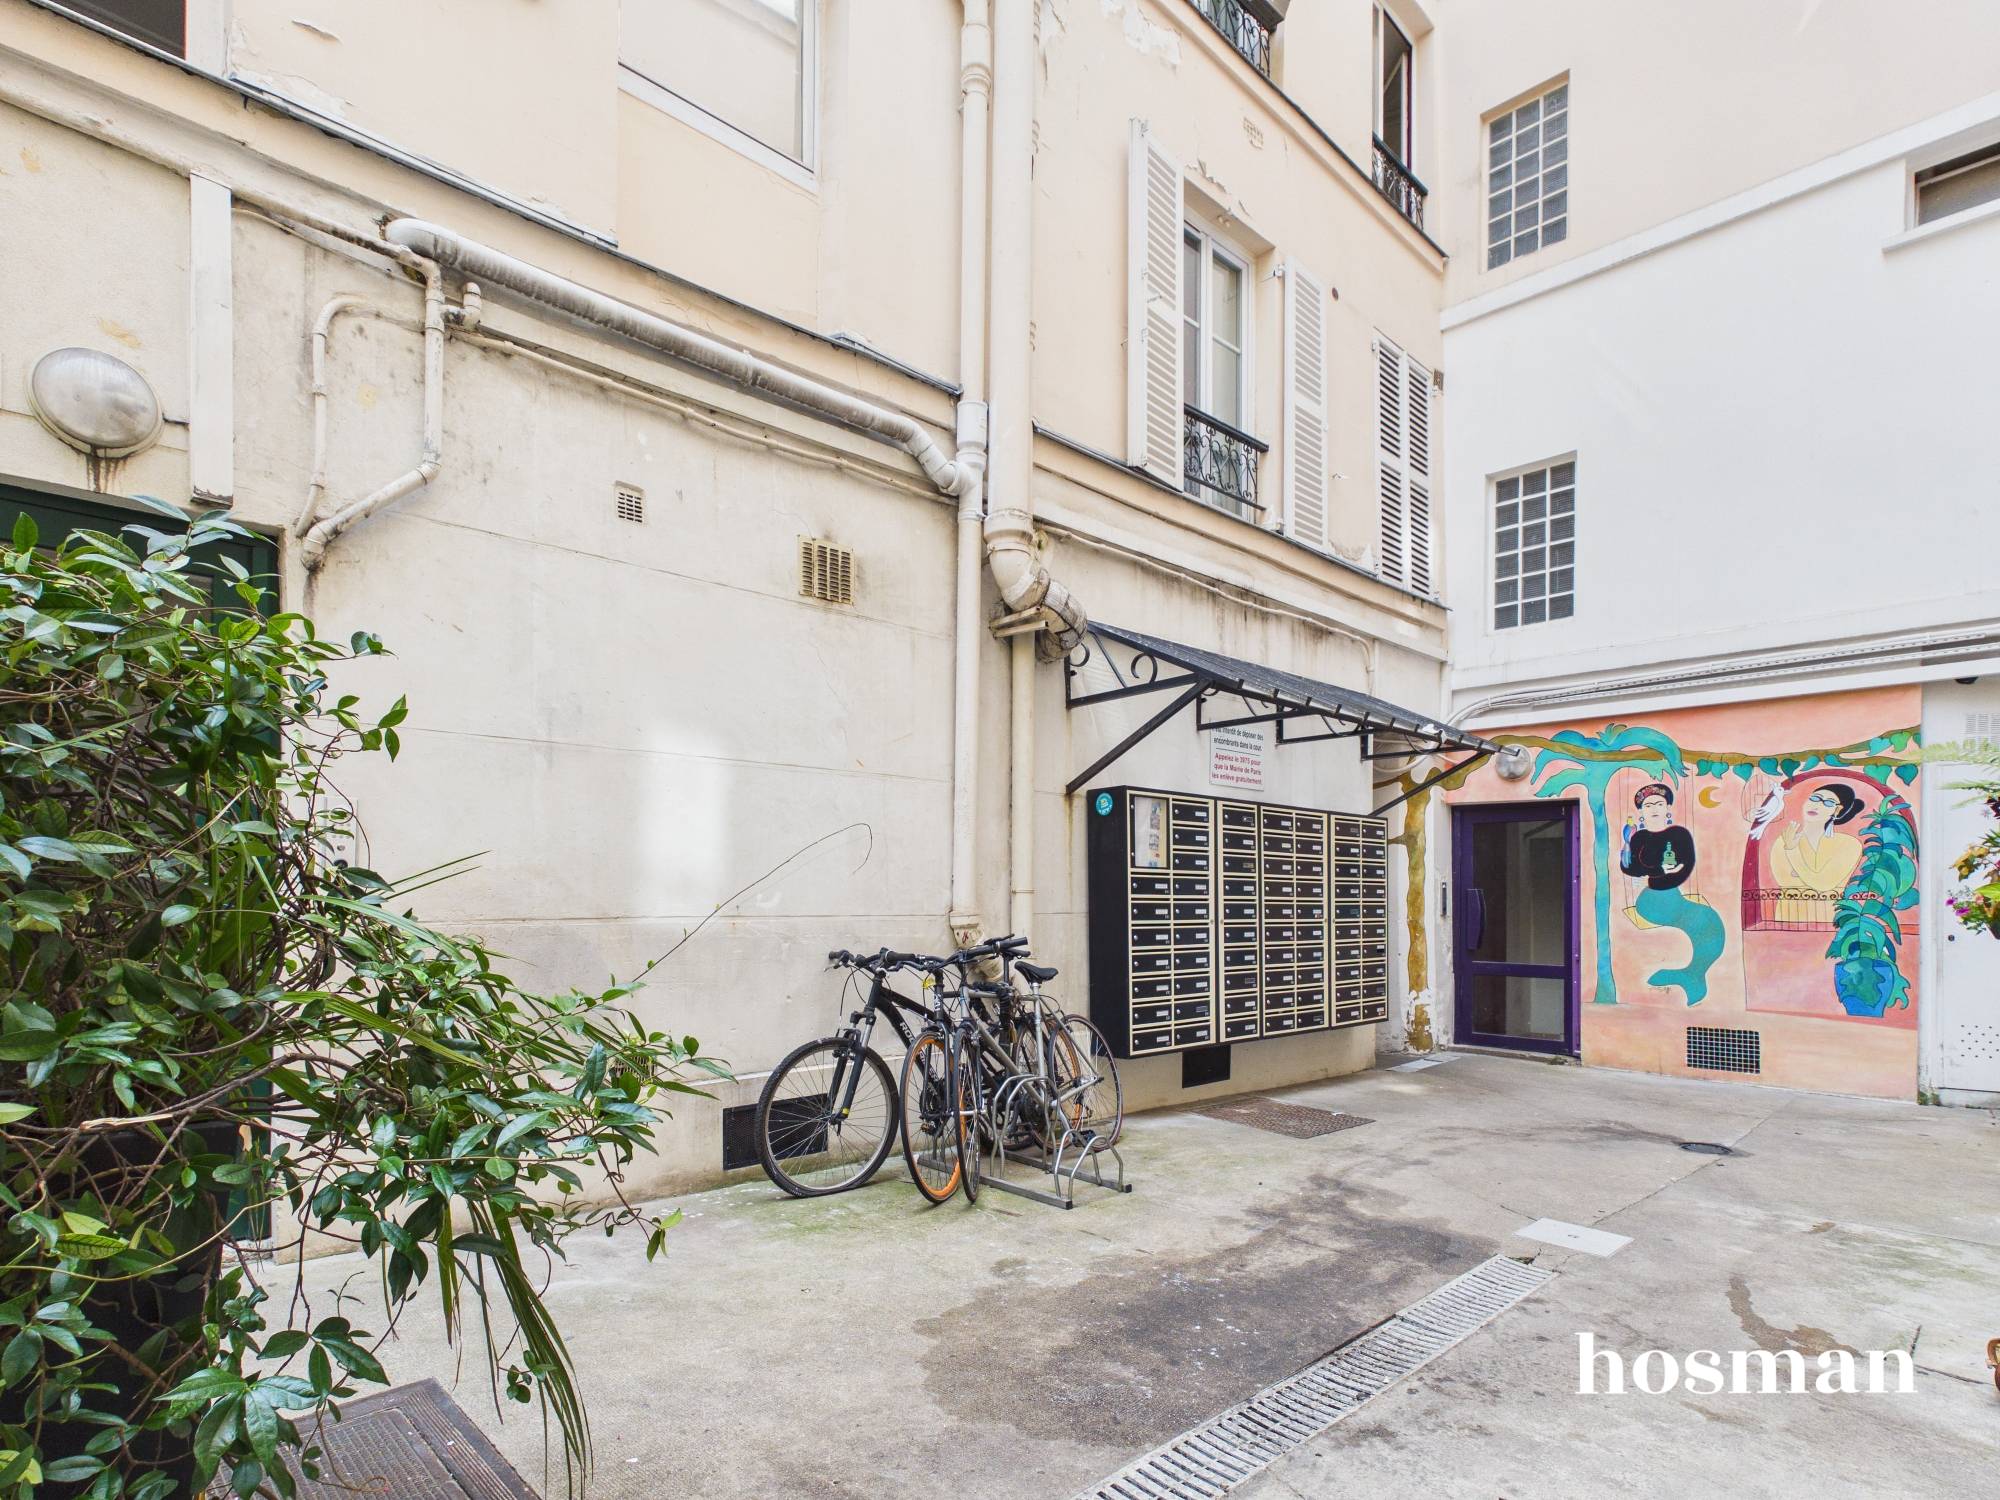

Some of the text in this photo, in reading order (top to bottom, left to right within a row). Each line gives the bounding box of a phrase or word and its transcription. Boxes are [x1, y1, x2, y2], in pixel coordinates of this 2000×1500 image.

[1214, 738, 1239, 747] encombrants
[1240, 740, 1248, 749] dans
[1215, 752, 1234, 762] Appelez
[1230, 764, 1243, 772] Mairie
[1250, 768, 1262, 776] Paris
